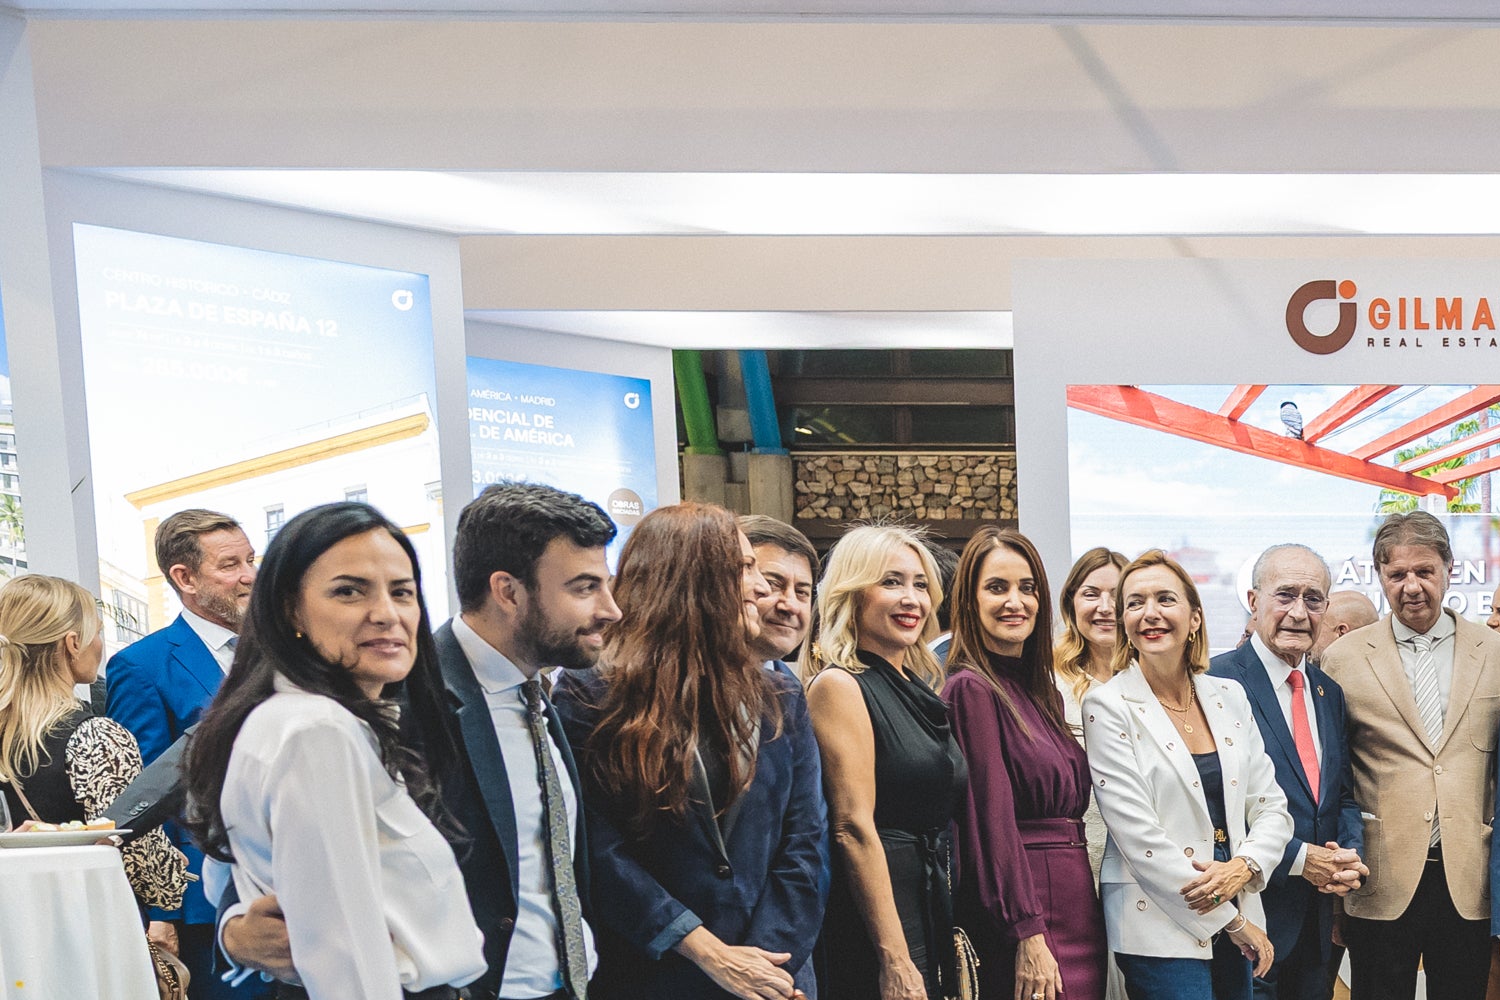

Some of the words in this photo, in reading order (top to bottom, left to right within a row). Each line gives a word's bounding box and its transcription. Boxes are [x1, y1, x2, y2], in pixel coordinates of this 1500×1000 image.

[105, 290, 184, 318] PLAZA
[188, 301, 218, 322] DE
[224, 306, 312, 334] ESPAÑA
[316, 318, 339, 338] 12
[1367, 337, 1423, 348] REAL
[470, 388, 513, 402] AMÉRICA
[520, 394, 556, 407] MADRID
[534, 414, 554, 429] DE
[479, 425, 500, 440] DE
[503, 428, 575, 448] AMÉRICA
[612, 499, 640, 510] OBRAS
